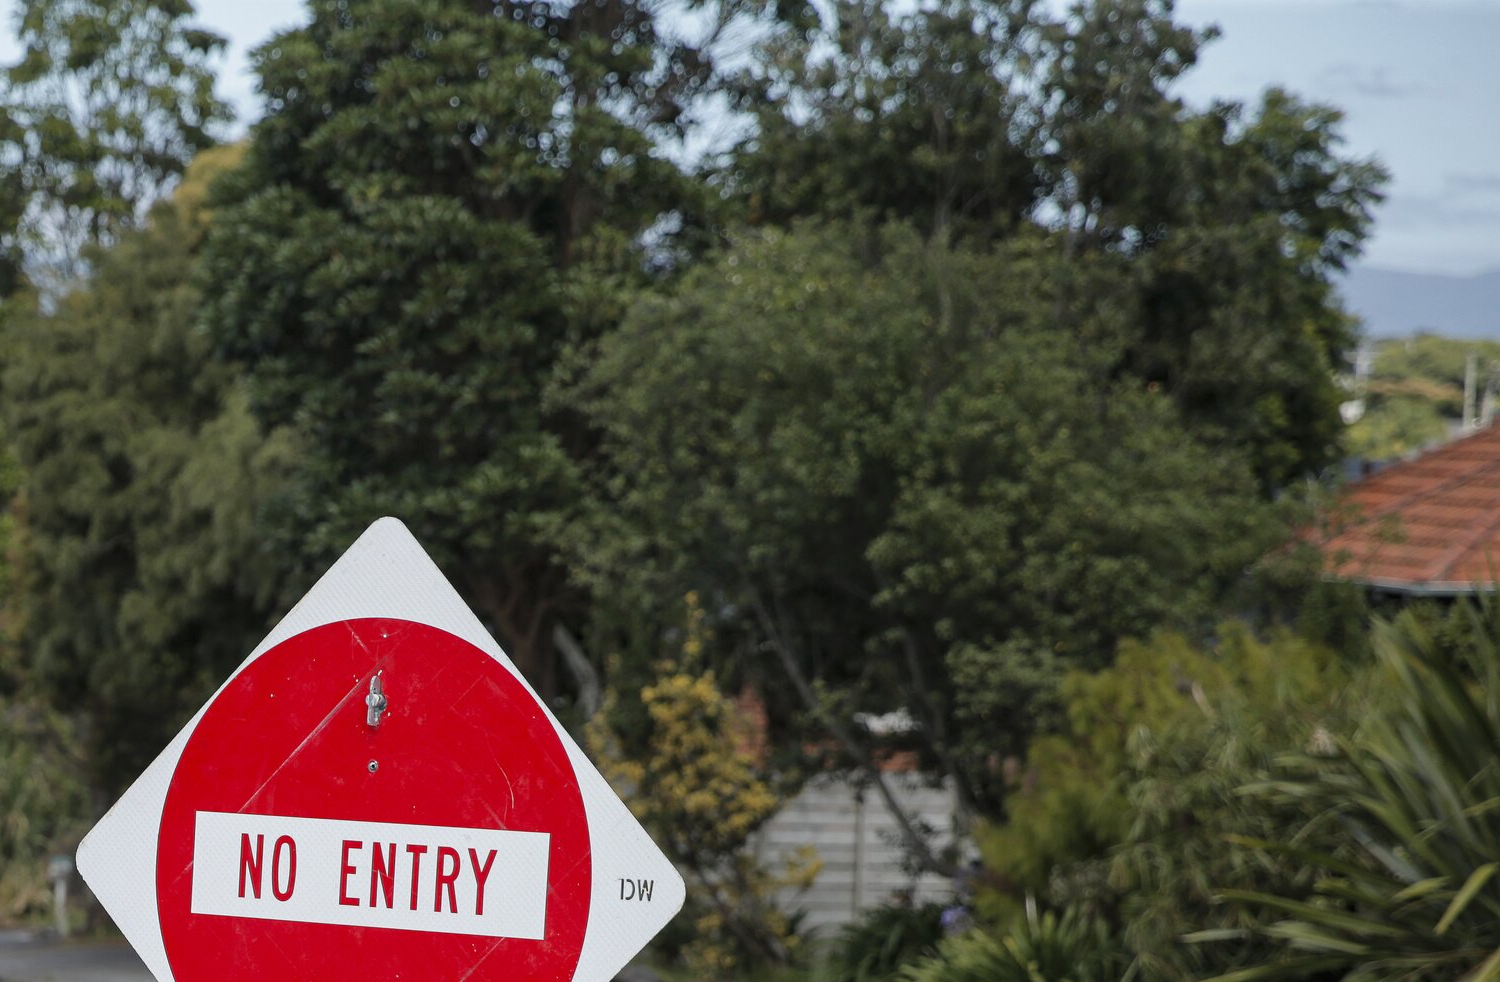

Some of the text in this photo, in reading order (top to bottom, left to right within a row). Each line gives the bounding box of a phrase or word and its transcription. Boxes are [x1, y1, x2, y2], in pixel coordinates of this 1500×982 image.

[238, 833, 499, 916] NO ENTRY
[620, 878, 654, 902] DW
